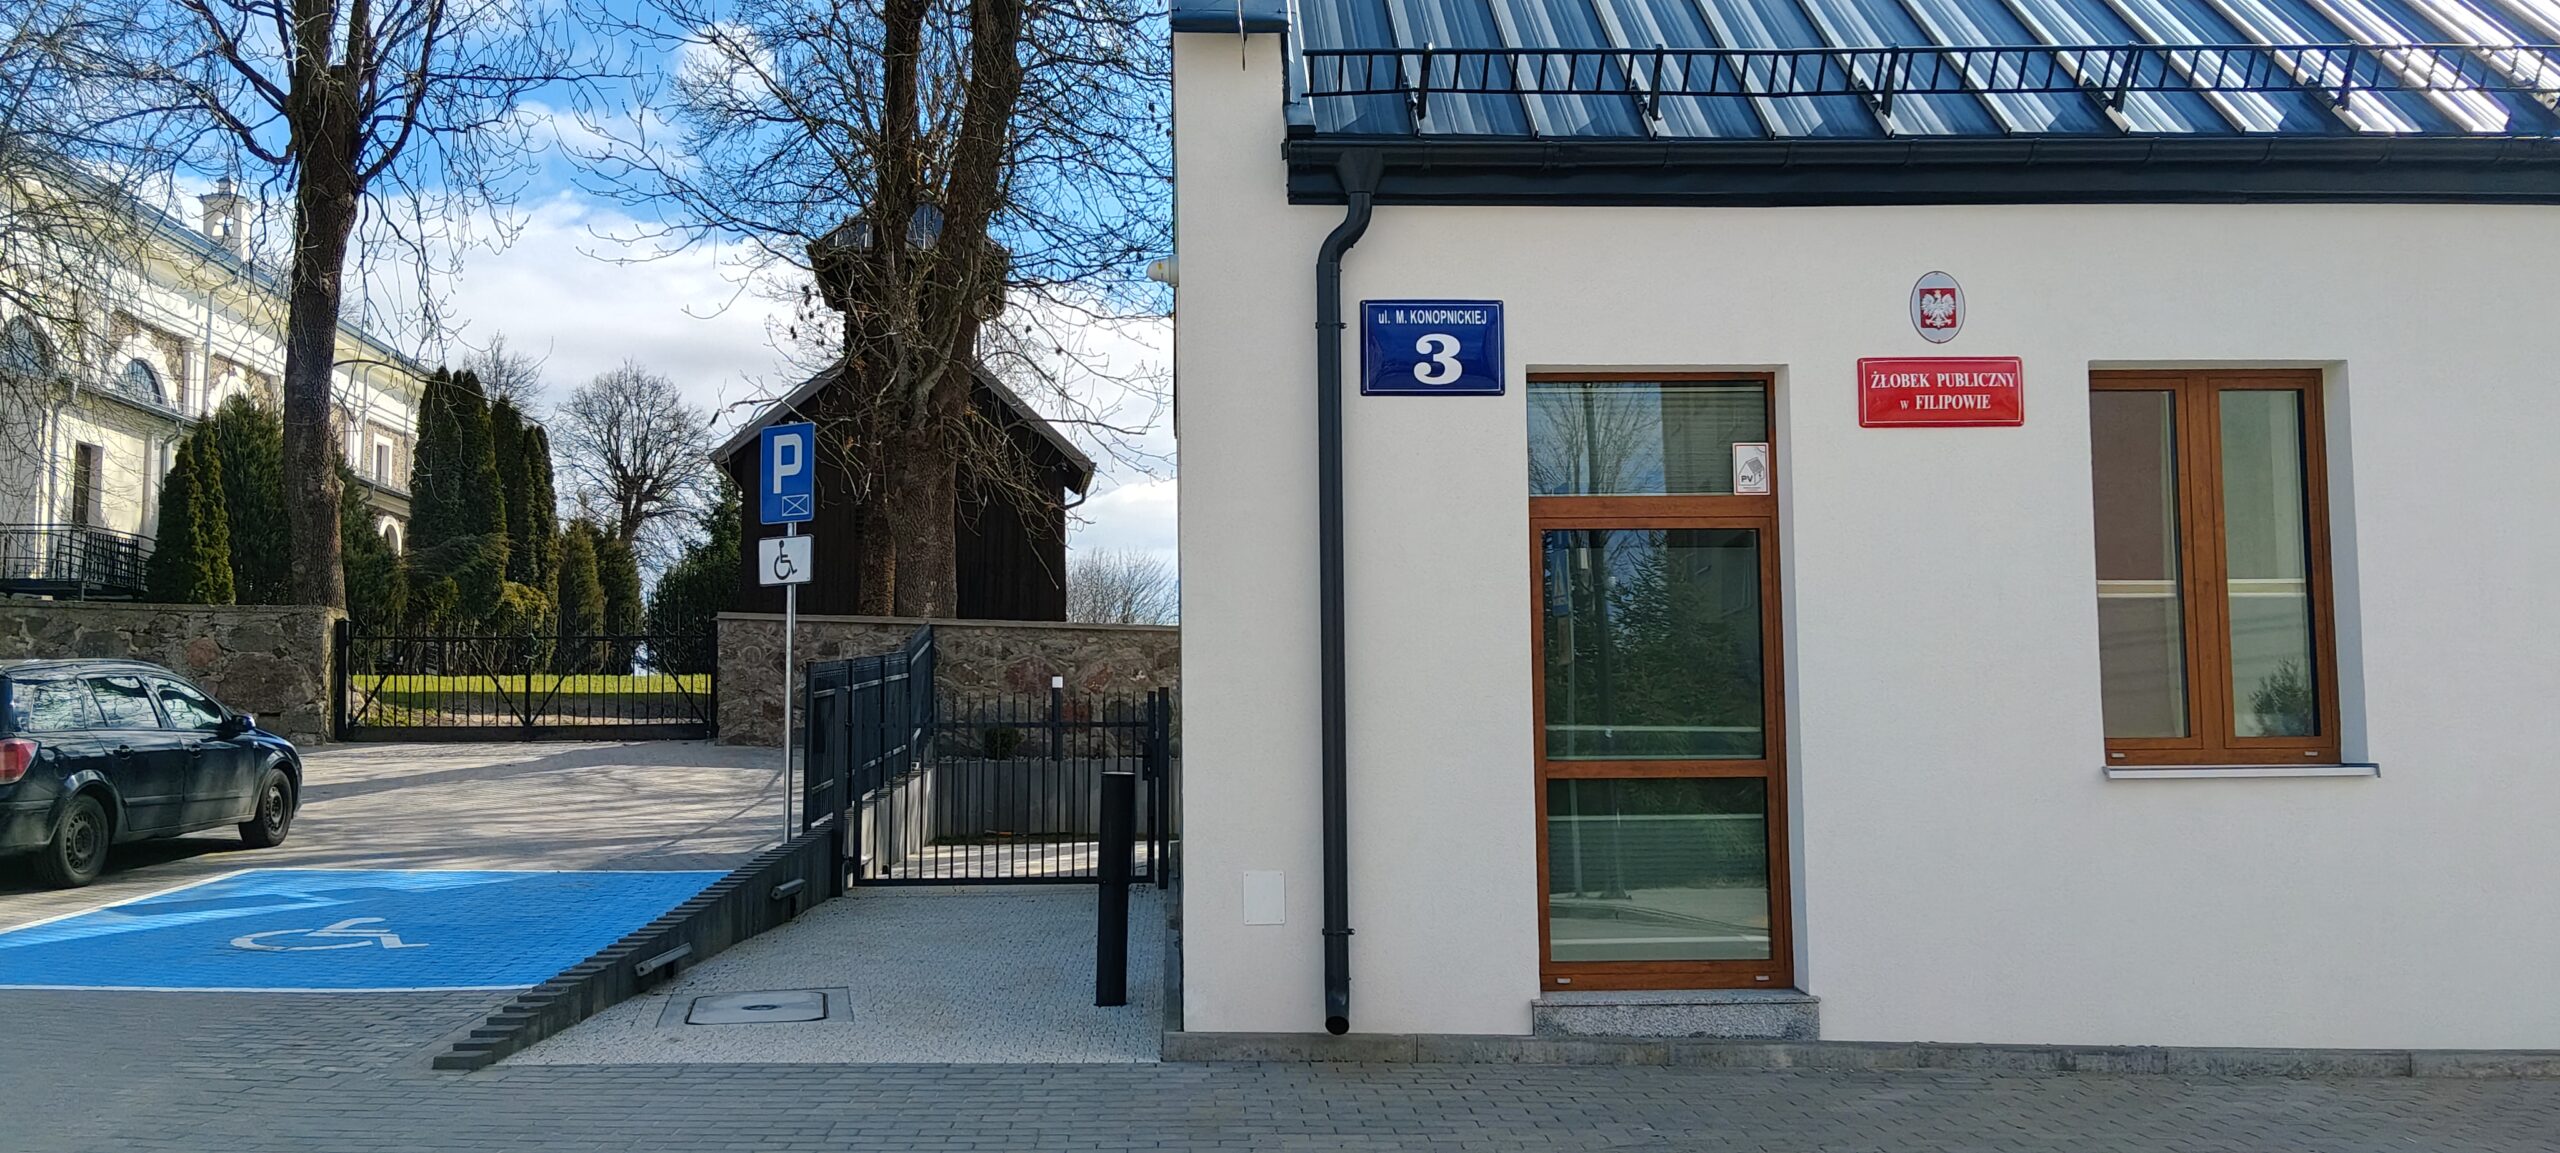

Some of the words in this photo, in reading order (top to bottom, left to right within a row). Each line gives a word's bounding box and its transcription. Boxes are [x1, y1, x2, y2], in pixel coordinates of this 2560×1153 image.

[1378, 309, 1391, 324] ul.
[1395, 309, 1408, 324] M.
[1410, 309, 1487, 325] KONOPNICKIEJ
[1413, 333, 1463, 385] 3
[1871, 371, 1930, 389] ŻŁOBEK
[1937, 372, 2016, 388] PUBLICZNY
[1915, 394, 1991, 410] FILIPOWIE
[773, 433, 803, 494] P
[1740, 475, 1753, 483] PV
